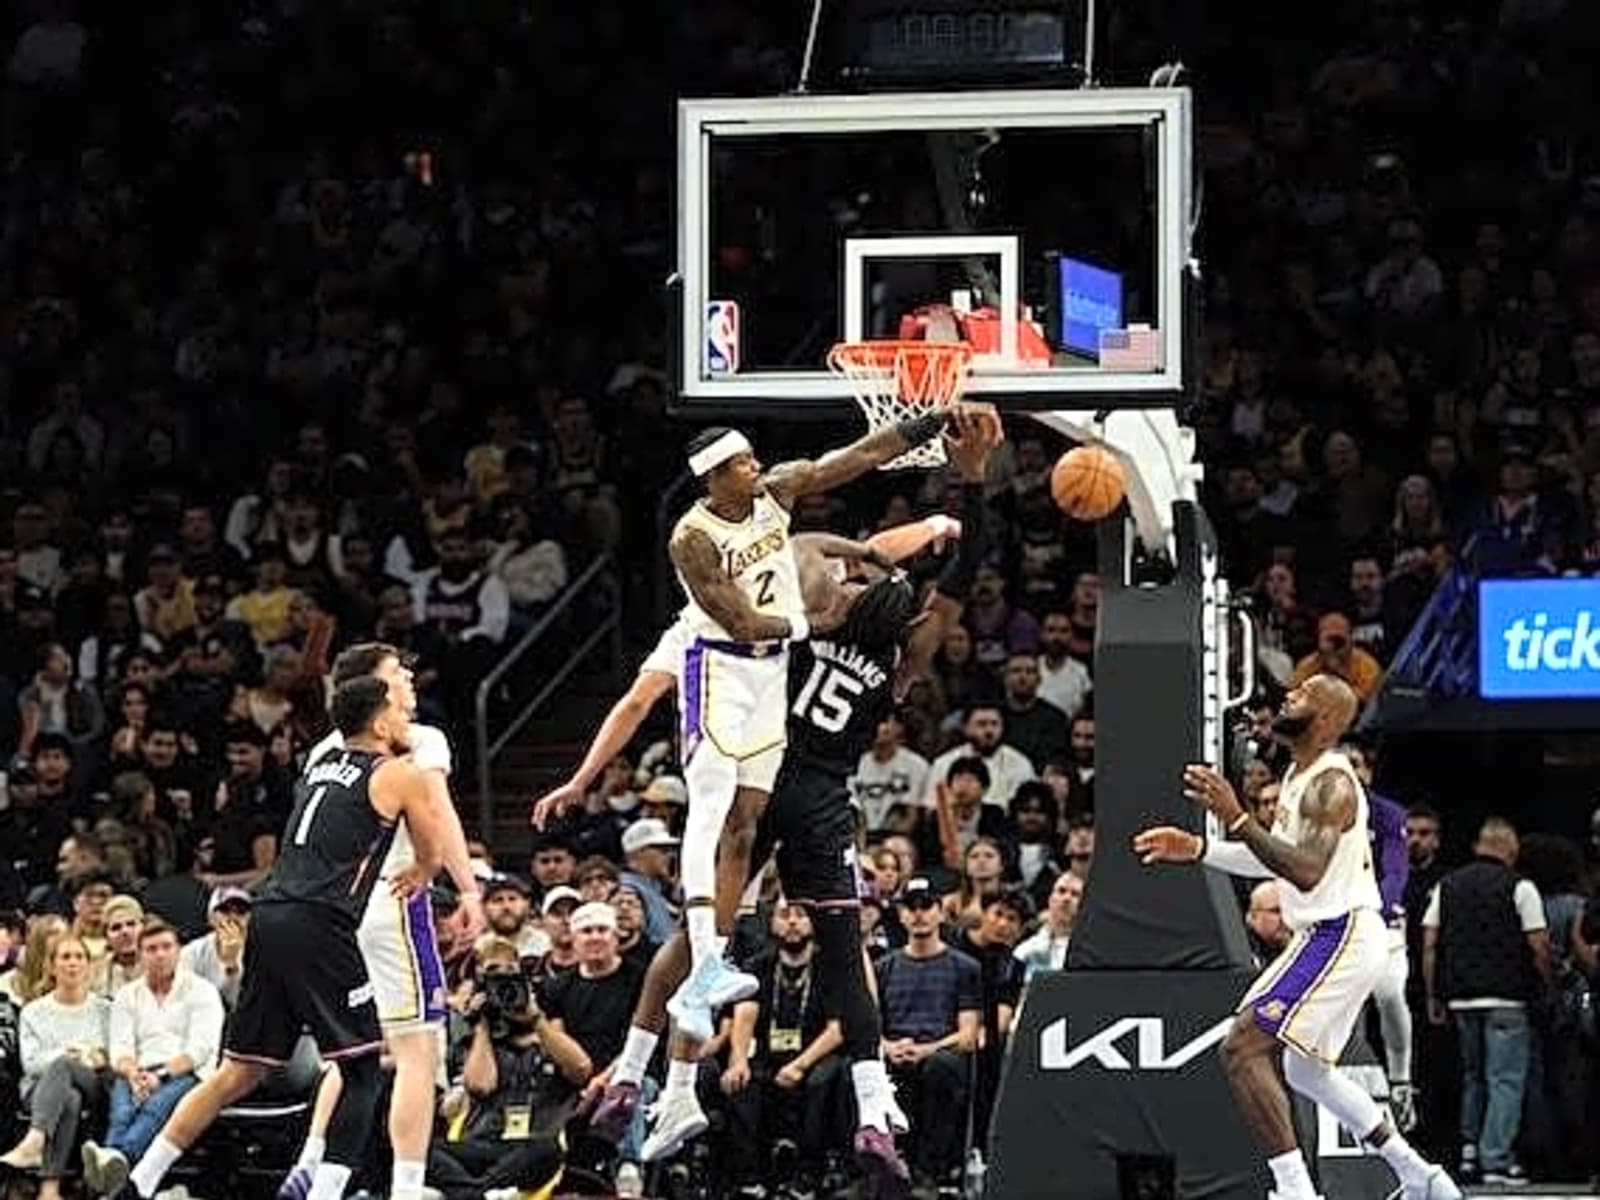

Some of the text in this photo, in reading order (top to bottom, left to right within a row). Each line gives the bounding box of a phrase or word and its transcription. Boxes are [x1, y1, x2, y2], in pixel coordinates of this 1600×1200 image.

[755, 570, 776, 609] 2
[1503, 610, 1600, 671] tick
[792, 660, 865, 733] 15
[294, 785, 328, 845] 1
